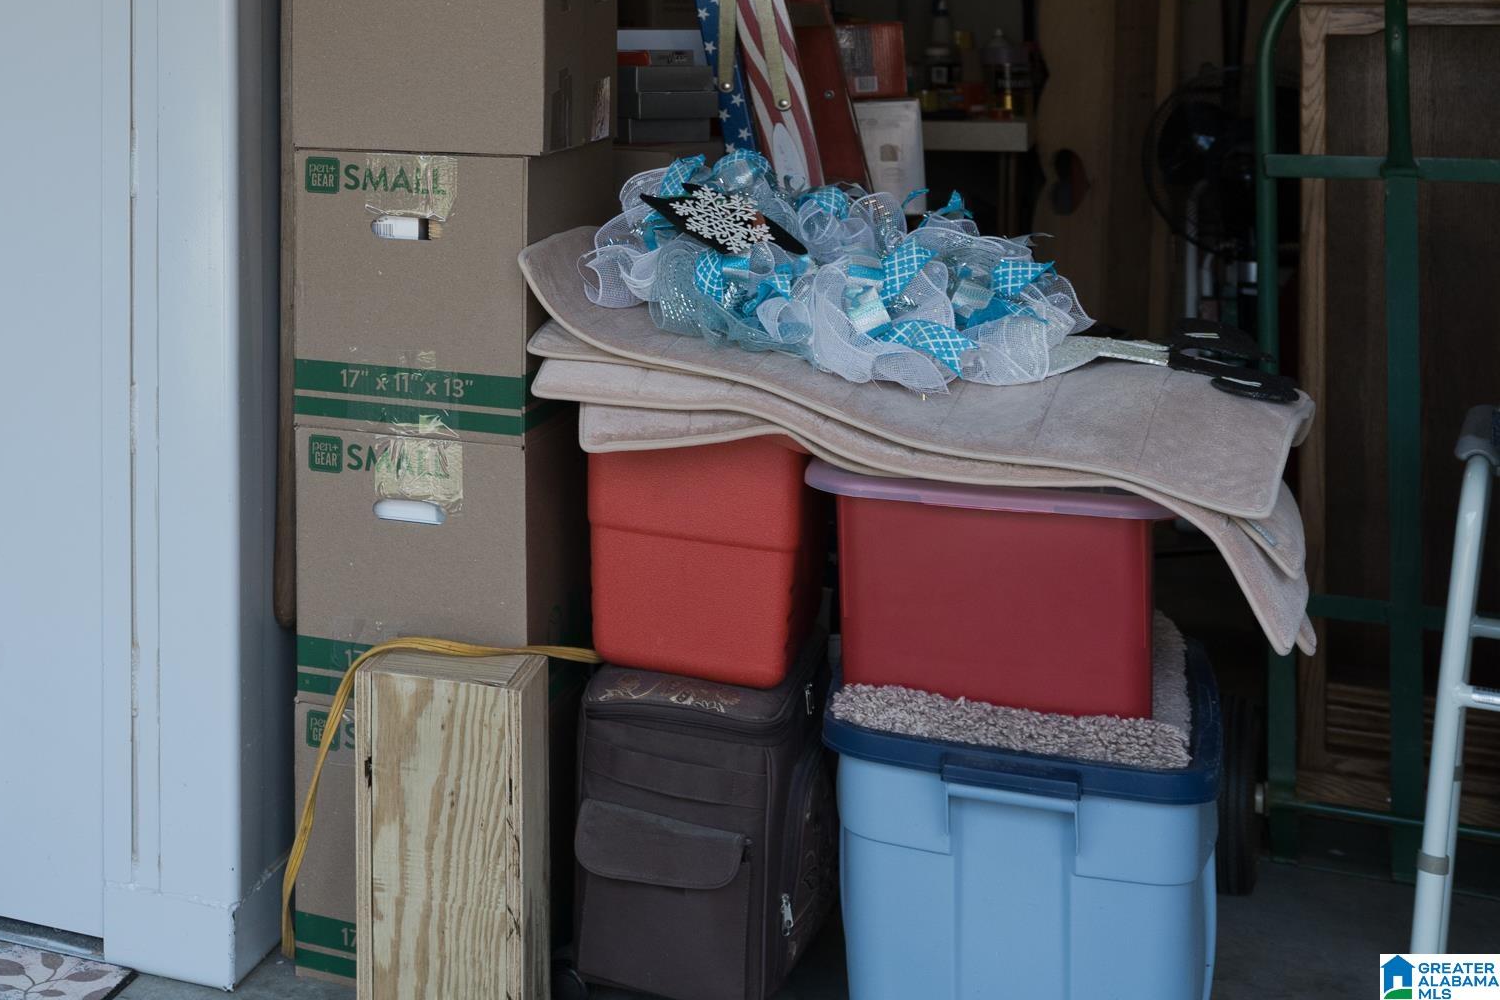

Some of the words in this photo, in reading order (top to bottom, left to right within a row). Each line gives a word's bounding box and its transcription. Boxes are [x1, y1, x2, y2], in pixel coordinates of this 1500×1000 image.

[311, 174, 334, 188] GEAR
[344, 164, 447, 195] SMALL
[340, 368, 369, 388] 17"
[375, 378, 386, 391] x
[425, 382, 436, 395] x
[315, 451, 337, 467] GEAR
